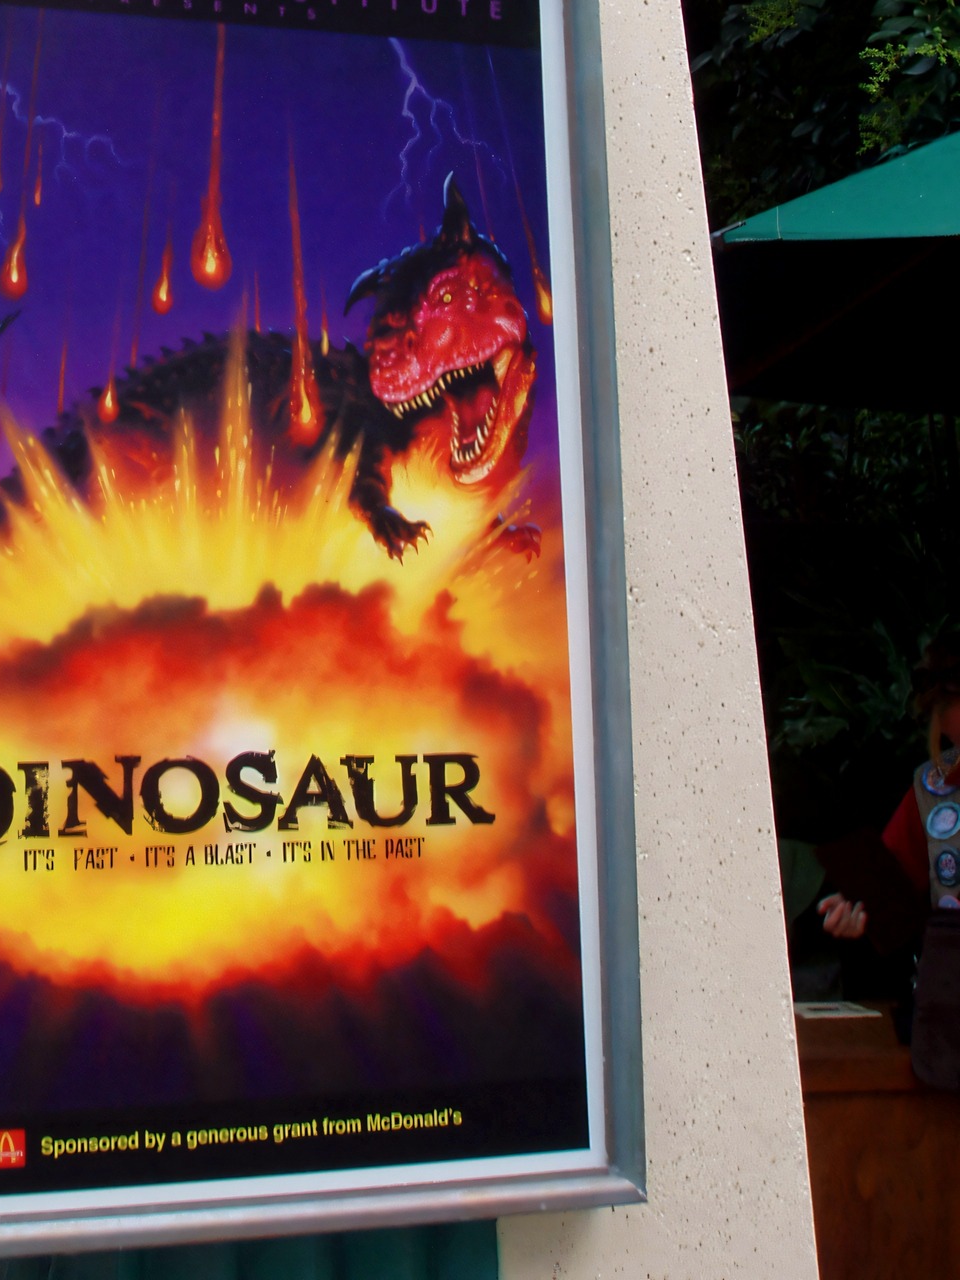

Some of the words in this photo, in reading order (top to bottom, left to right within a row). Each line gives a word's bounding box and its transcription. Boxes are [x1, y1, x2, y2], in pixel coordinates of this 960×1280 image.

[23, 848, 55, 872] IT'S
[73, 846, 119, 871] FAST
[145, 845, 176, 868] IT'S
[185, 844, 196, 867] A
[204, 841, 257, 865] BLAST
[282, 840, 312, 863] IT'S
[320, 839, 335, 862] IN
[343, 838, 376, 860] THE
[385, 837, 425, 860] PAST
[41, 1130, 139, 1159] Sponsored
[145, 1129, 166, 1153] by
[171, 1130, 182, 1147] a
[186, 1125, 269, 1150] generous
[273, 1118, 318, 1144] grant
[322, 1116, 362, 1136] from
[366, 1107, 462, 1132] McDonald's
